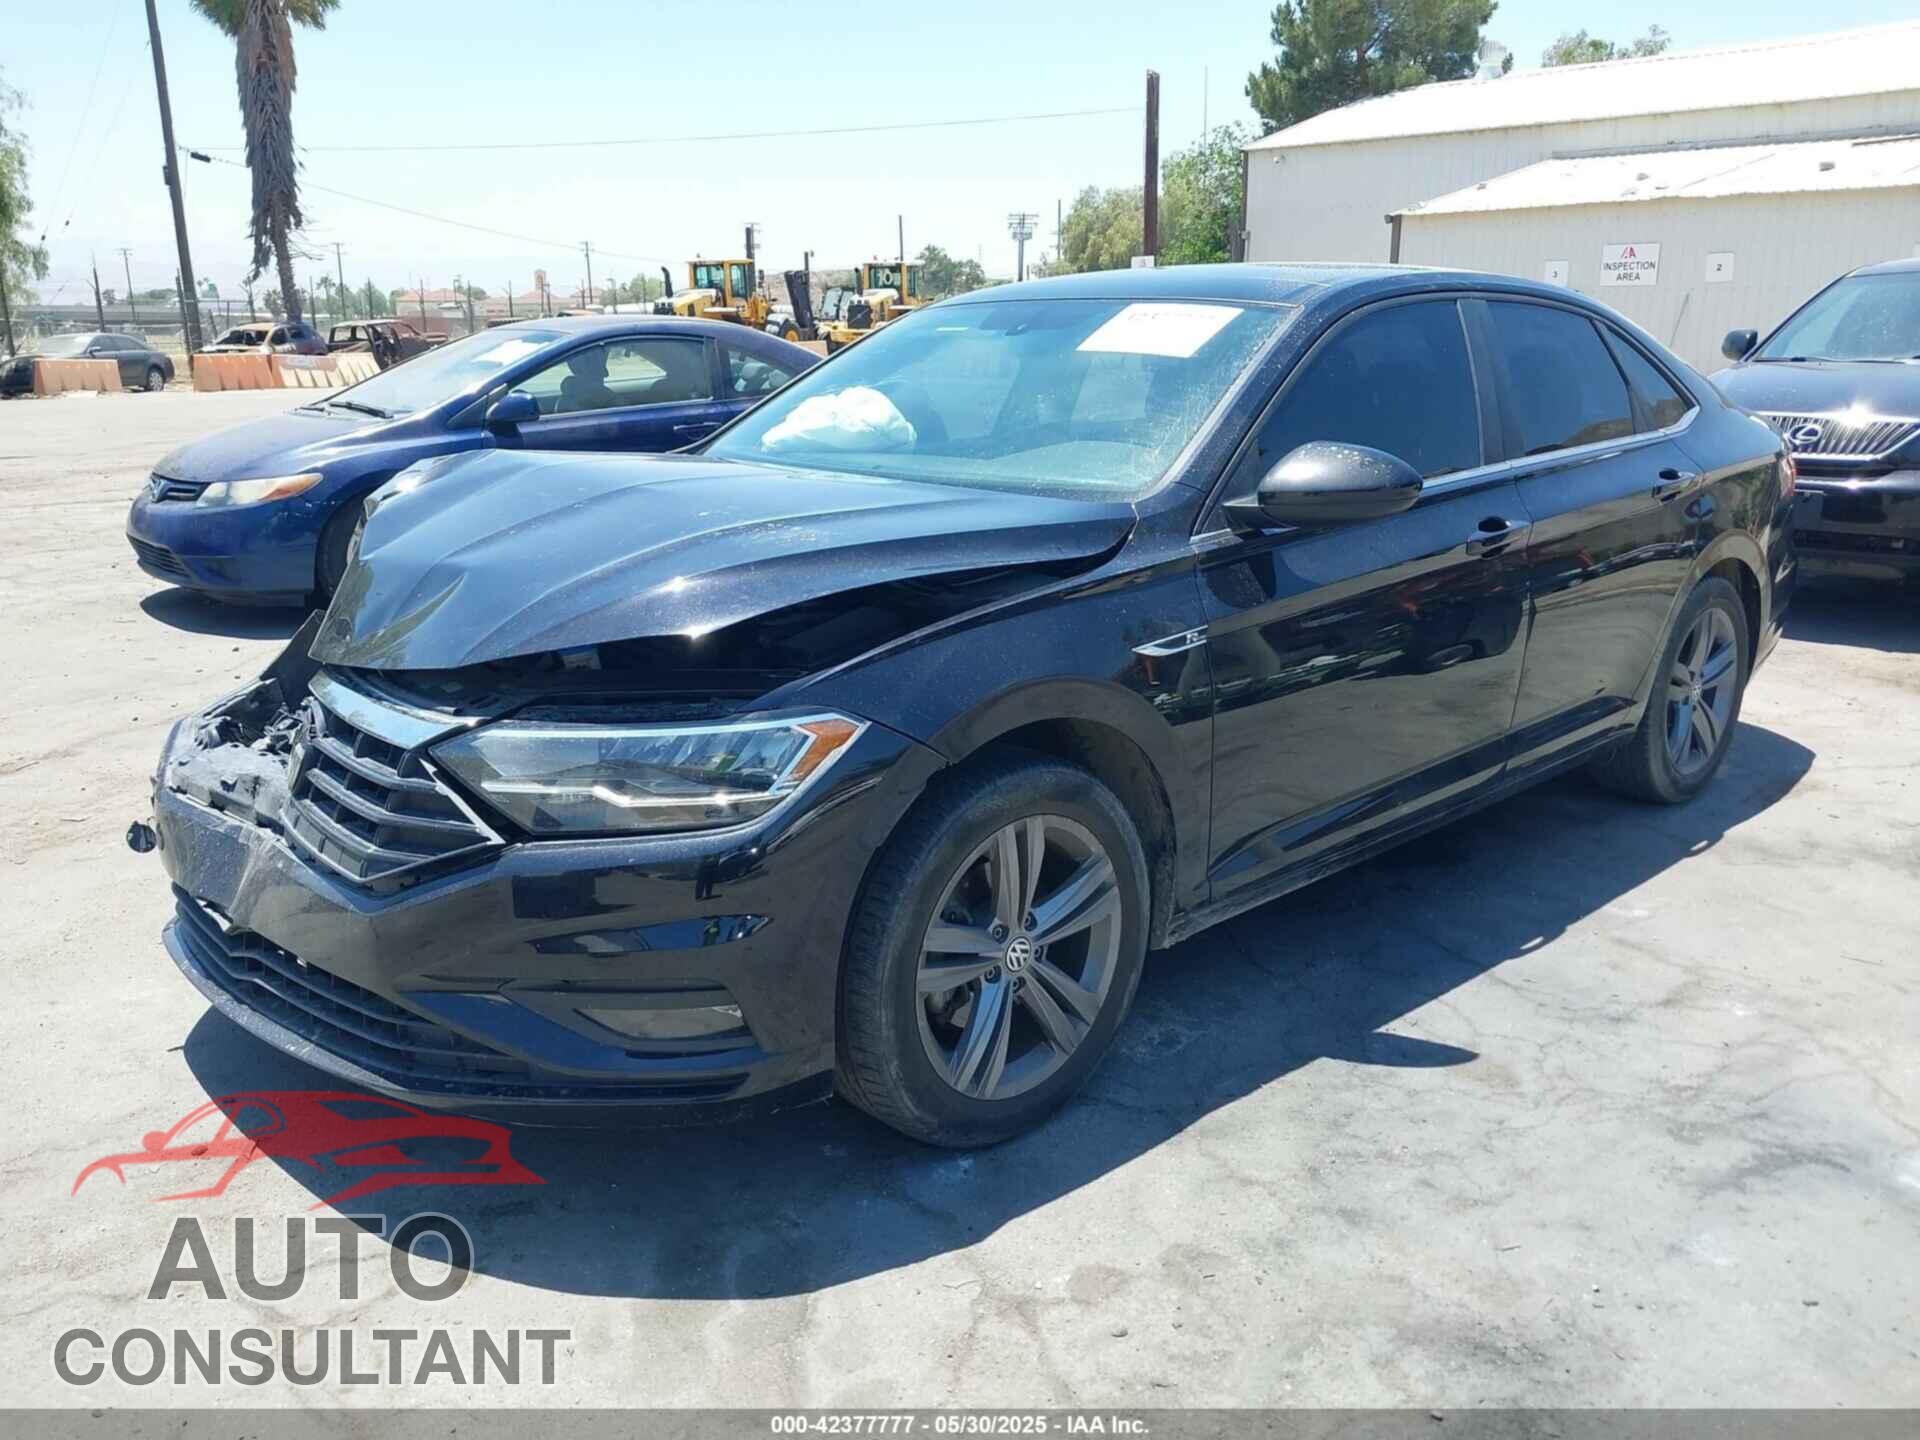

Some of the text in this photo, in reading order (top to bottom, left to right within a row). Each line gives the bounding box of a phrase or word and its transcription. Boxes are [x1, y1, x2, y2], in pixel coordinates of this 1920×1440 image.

[1603, 261, 1656, 271] INSPECTION
[1716, 263, 1722, 271] 2
[1616, 272, 1640, 281] AREA
